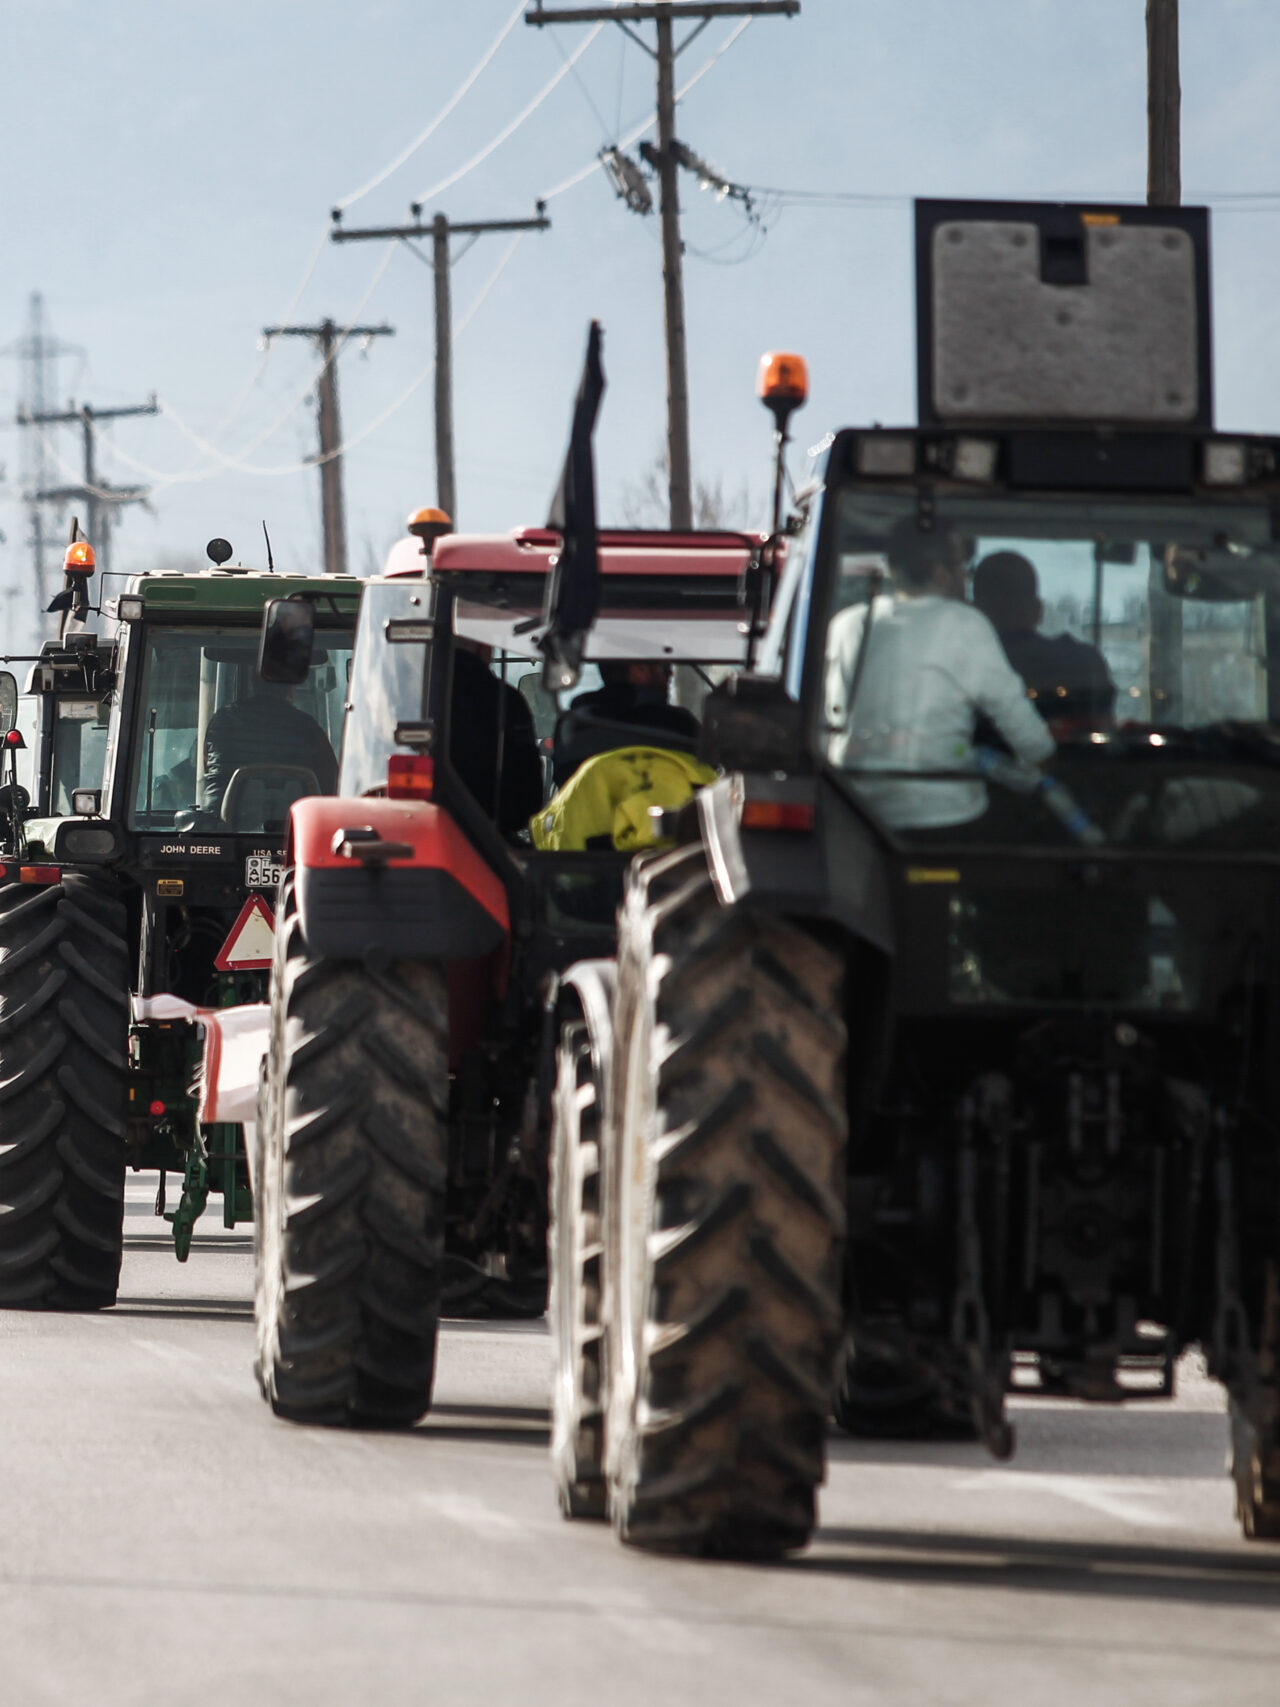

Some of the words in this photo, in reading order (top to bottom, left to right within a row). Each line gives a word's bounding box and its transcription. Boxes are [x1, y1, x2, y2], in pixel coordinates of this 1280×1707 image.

[160, 845, 186, 854] JOHN
[190, 846, 221, 855] DEERE
[253, 849, 272, 857] USA
